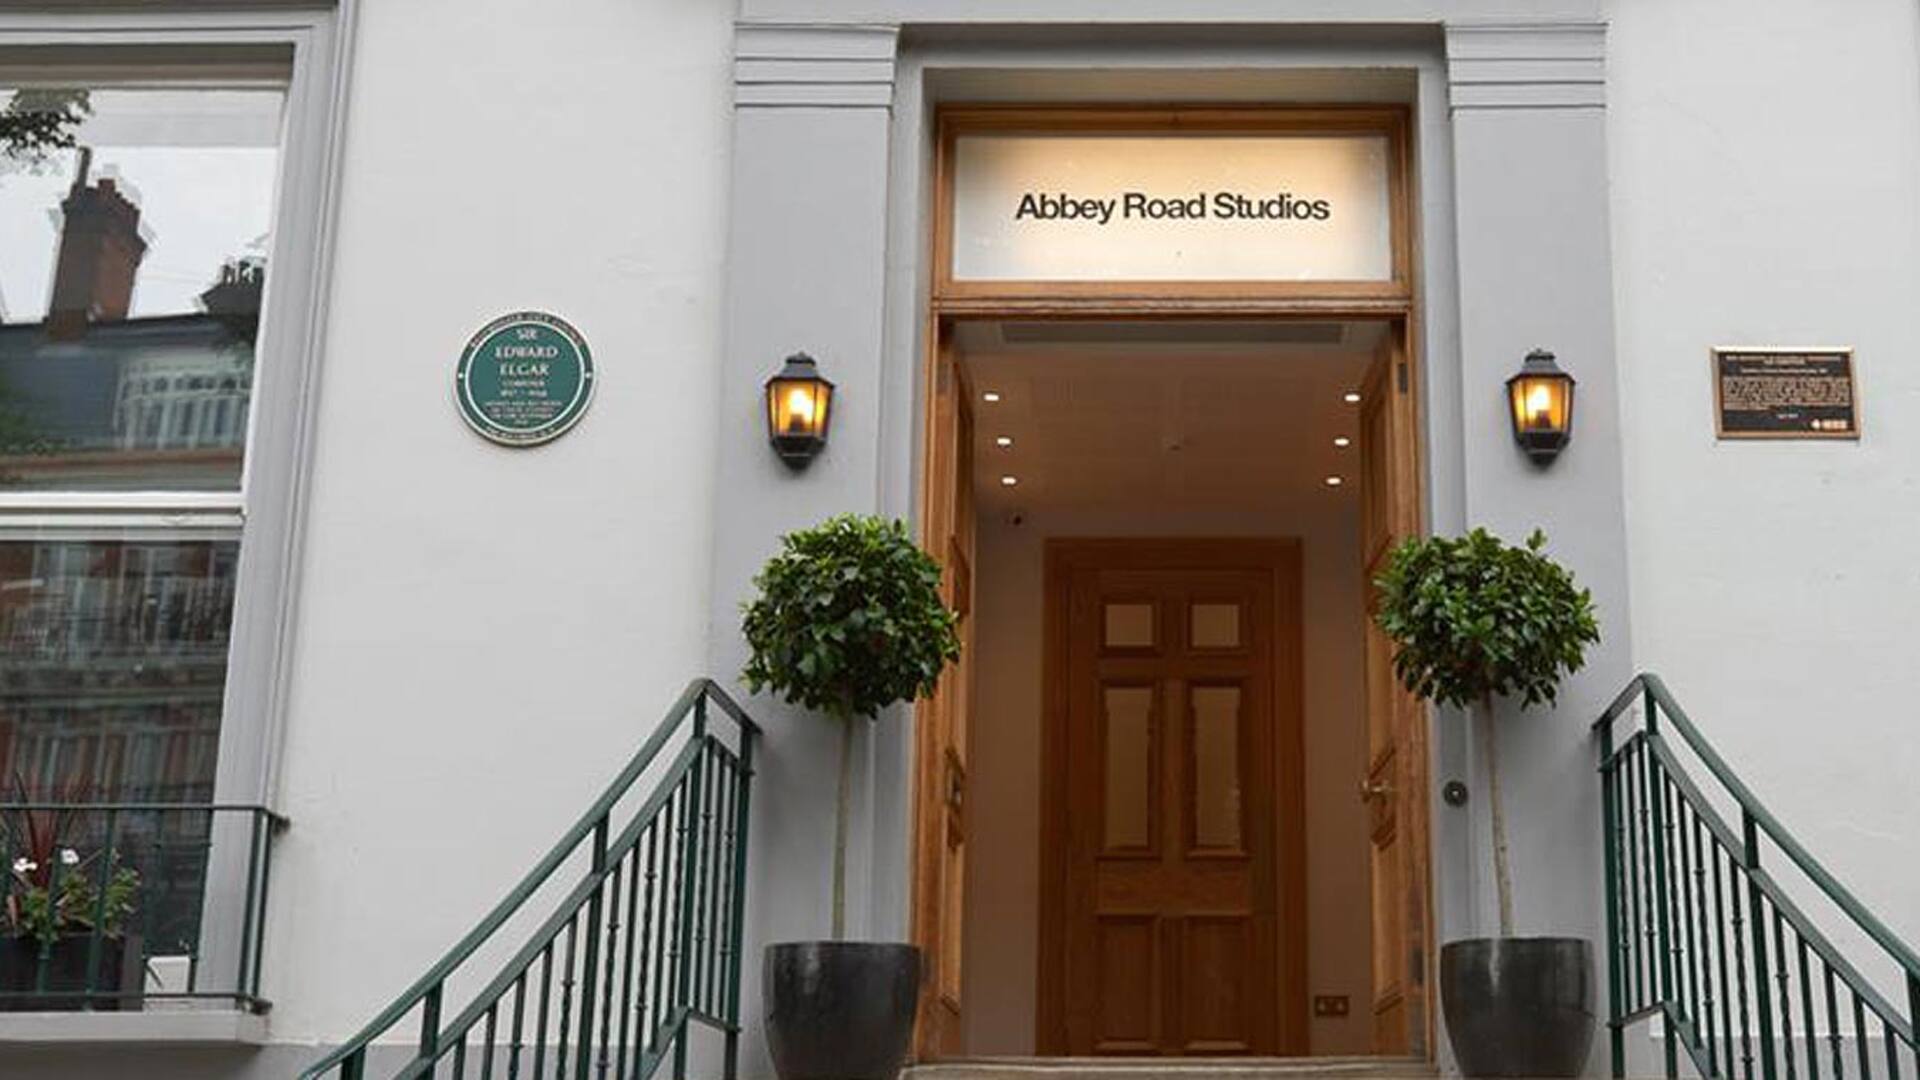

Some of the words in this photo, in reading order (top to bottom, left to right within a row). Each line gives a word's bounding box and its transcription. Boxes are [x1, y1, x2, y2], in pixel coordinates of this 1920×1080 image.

[1016, 193, 1115, 225] Abbey
[1124, 193, 1206, 219] Road
[1213, 192, 1330, 220] Studios
[494, 346, 559, 358] EDWARD
[499, 363, 550, 375] ELGAR
